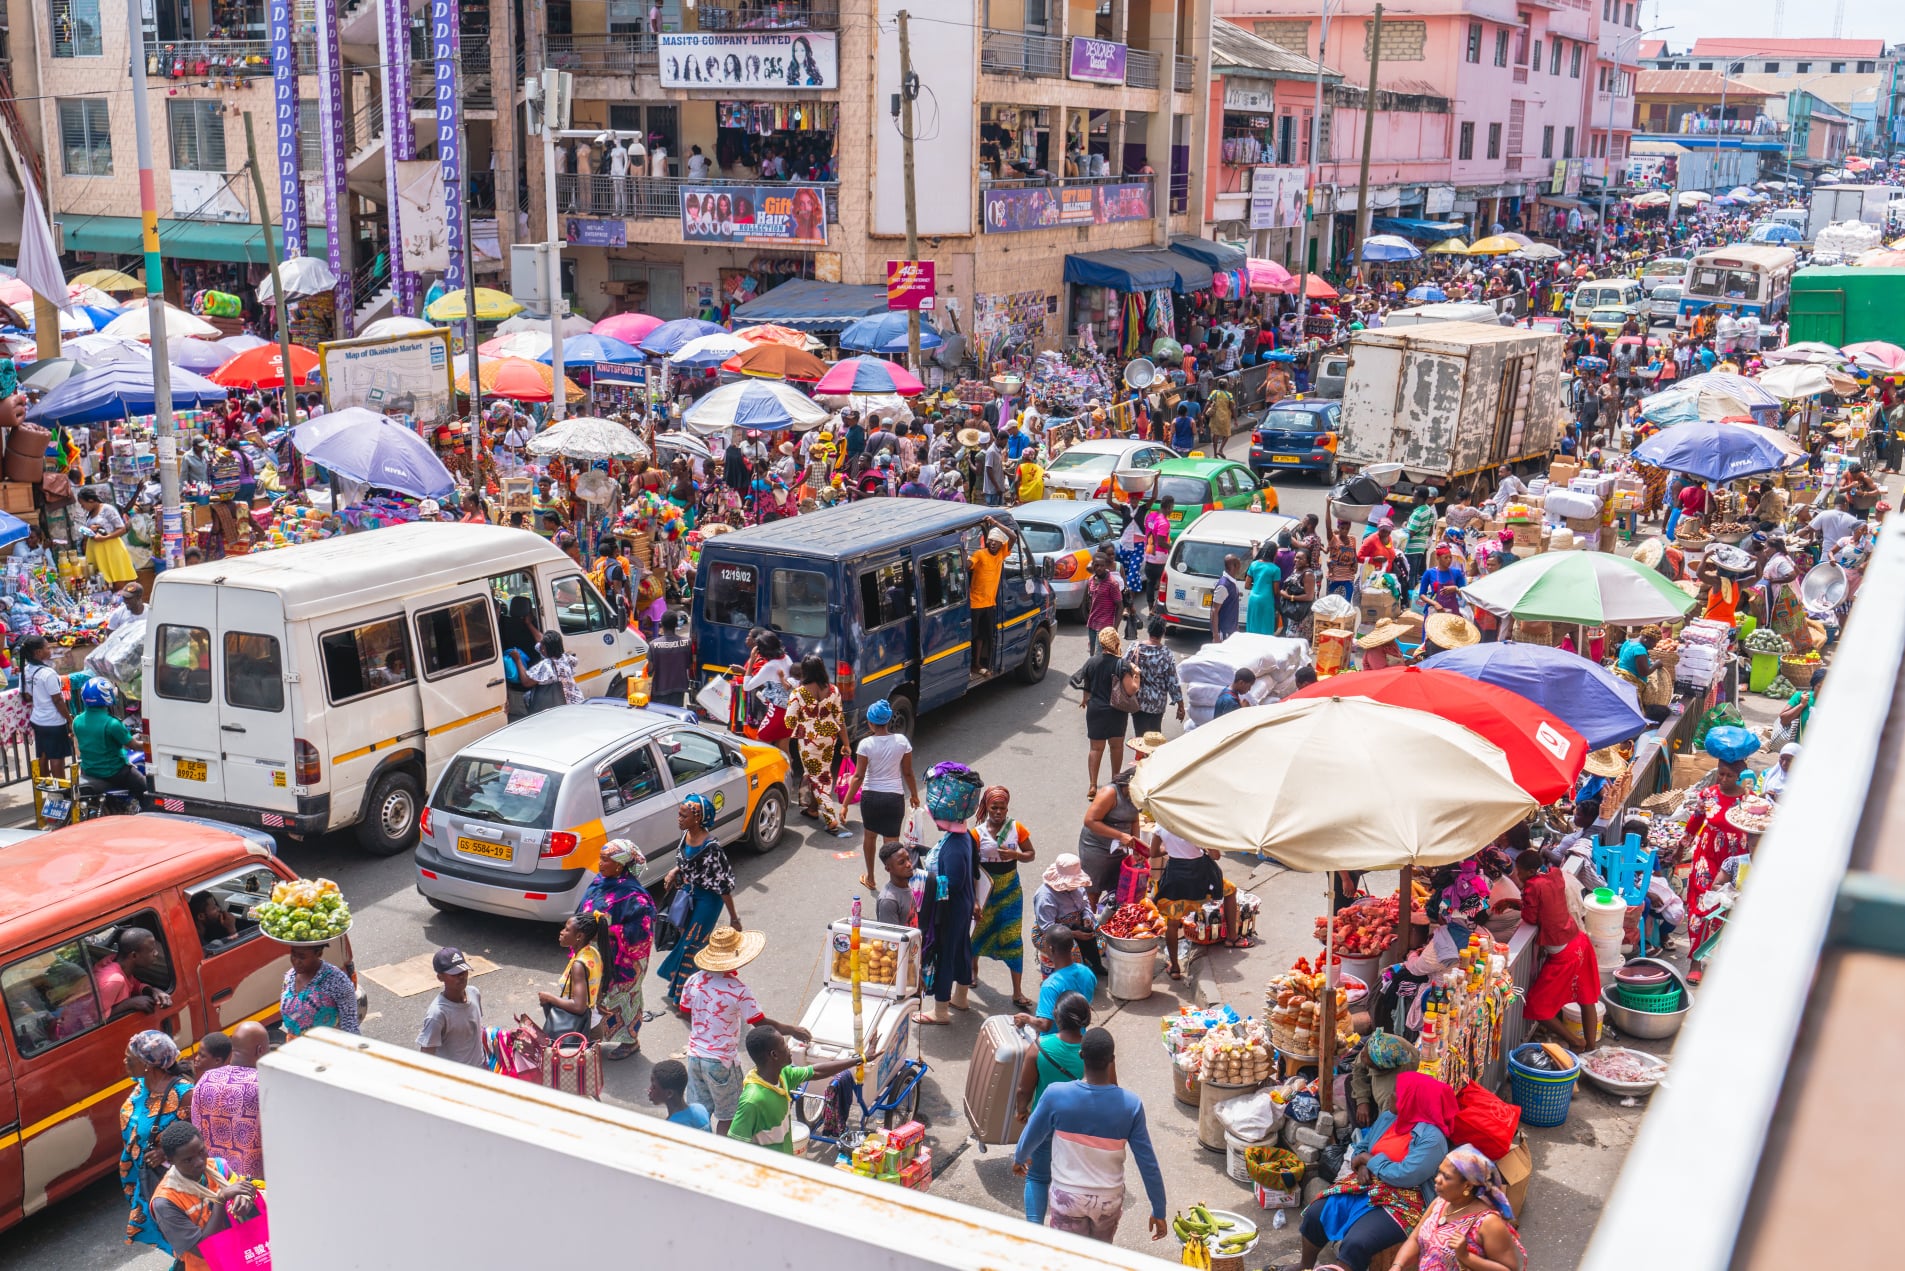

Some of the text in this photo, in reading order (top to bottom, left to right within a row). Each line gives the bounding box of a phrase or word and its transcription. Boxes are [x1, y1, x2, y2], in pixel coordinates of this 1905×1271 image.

[662, 36, 790, 46] MASITO COMPANY LIMTED
[765, 196, 792, 214] Gift
[757, 212, 784, 224] Hair
[739, 224, 784, 232] KOLLECTION
[898, 266, 916, 276] 4G
[345, 351, 360, 360] Map
[360, 350, 368, 358] of
[400, 342, 422, 352] Market
[596, 362, 633, 376] KNUTSFORD
[721, 569, 751, 582] 12/19/02
[188, 762, 196, 770] GE
[177, 769, 206, 780] 8992-15
[460, 840, 504, 856] GS 5584-19
